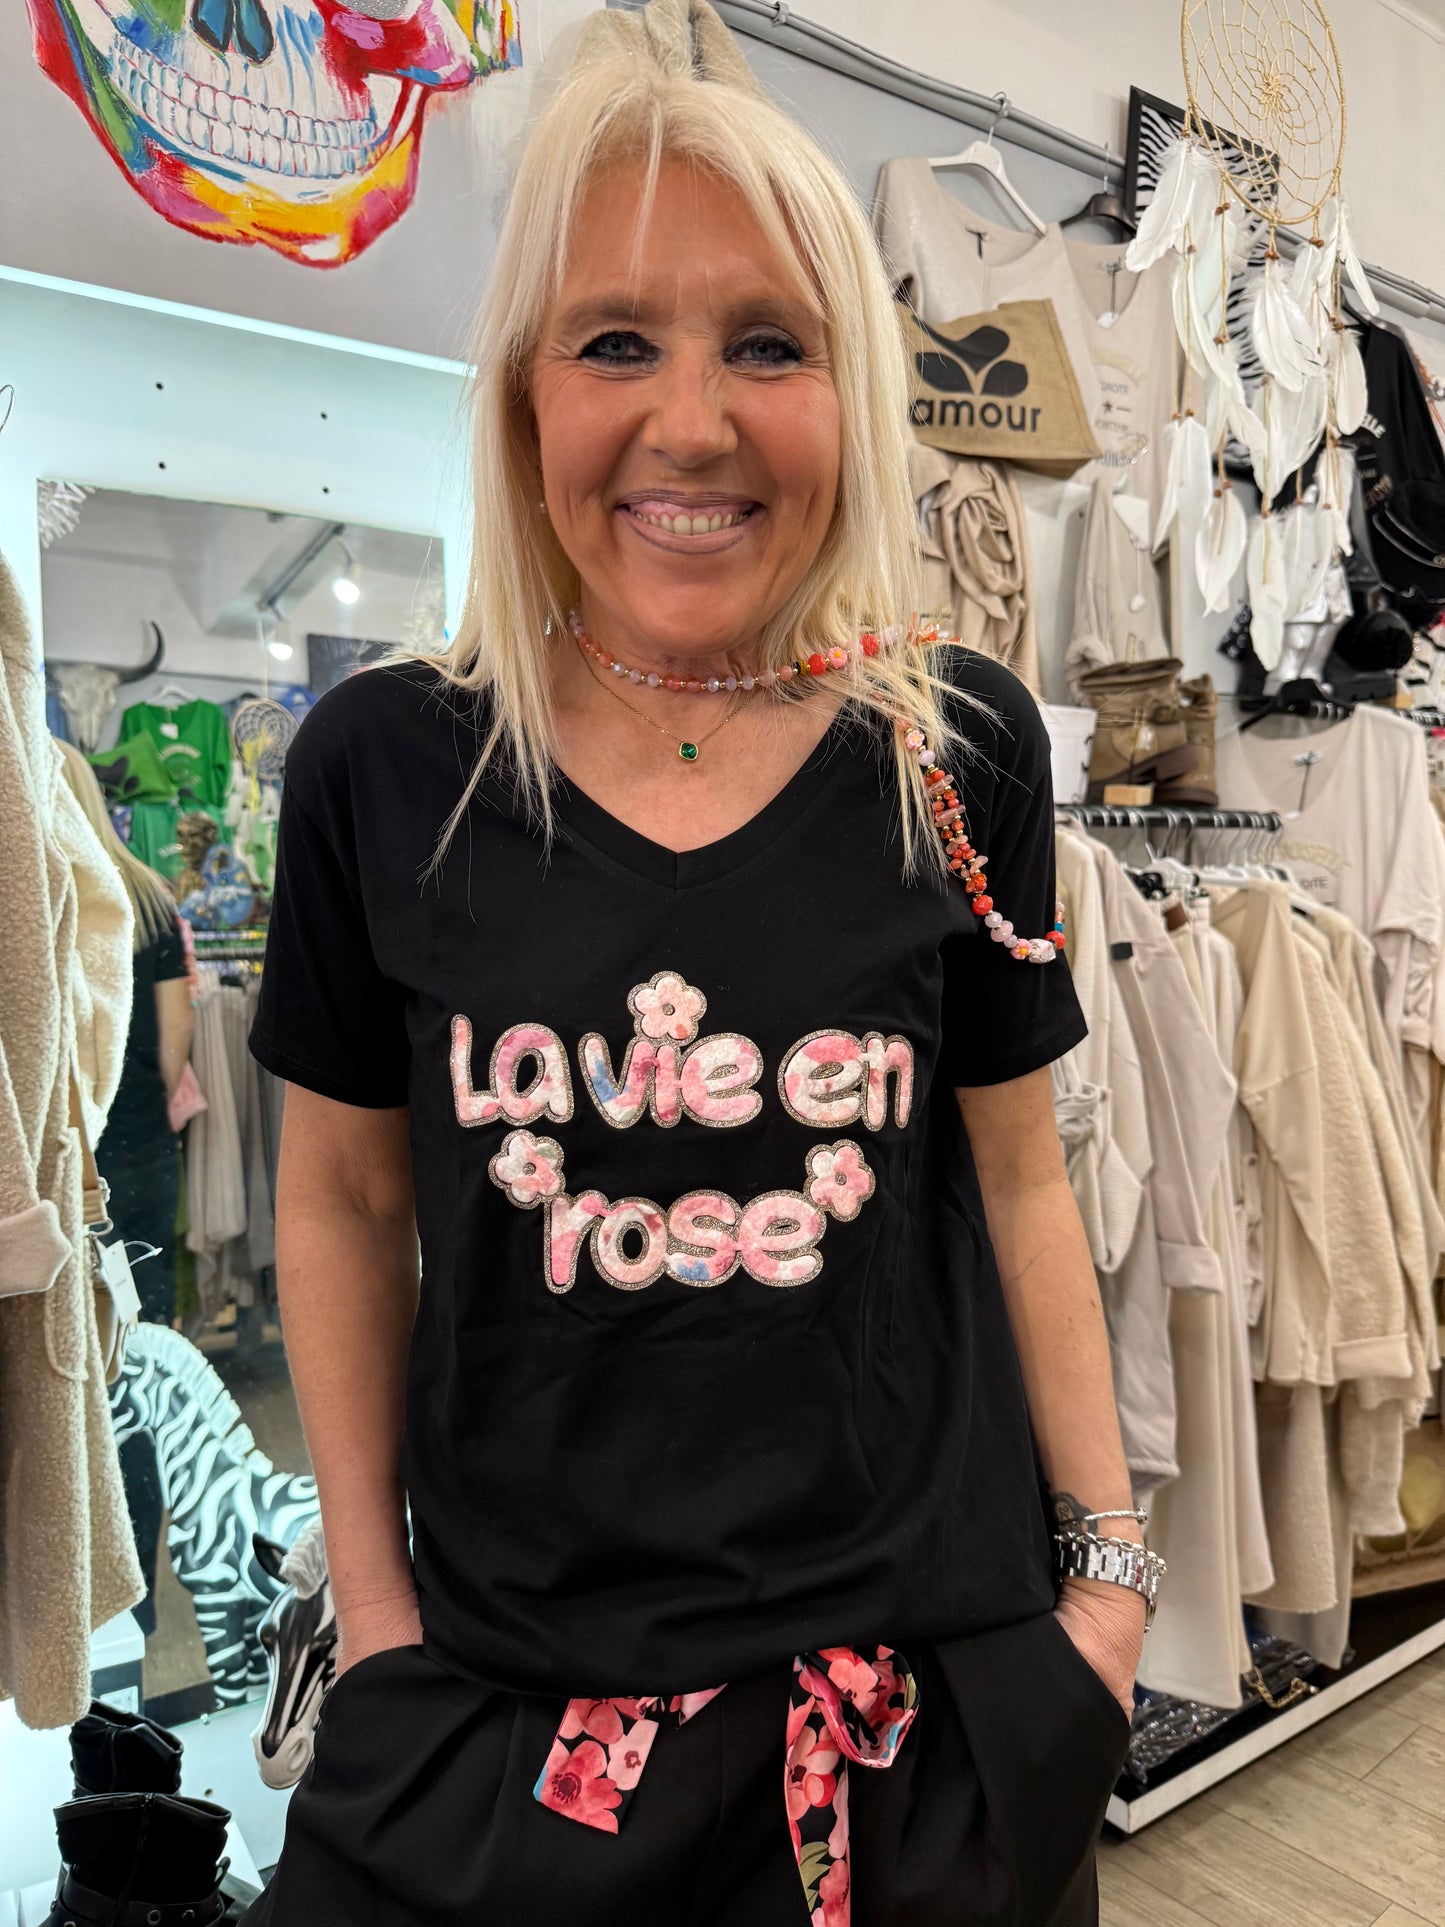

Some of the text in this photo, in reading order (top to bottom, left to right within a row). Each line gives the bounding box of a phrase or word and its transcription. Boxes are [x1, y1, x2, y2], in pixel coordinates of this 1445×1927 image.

[909, 399, 1041, 433] amour
[449, 970, 914, 1132] La vie en
[543, 1188, 827, 1295] rose
